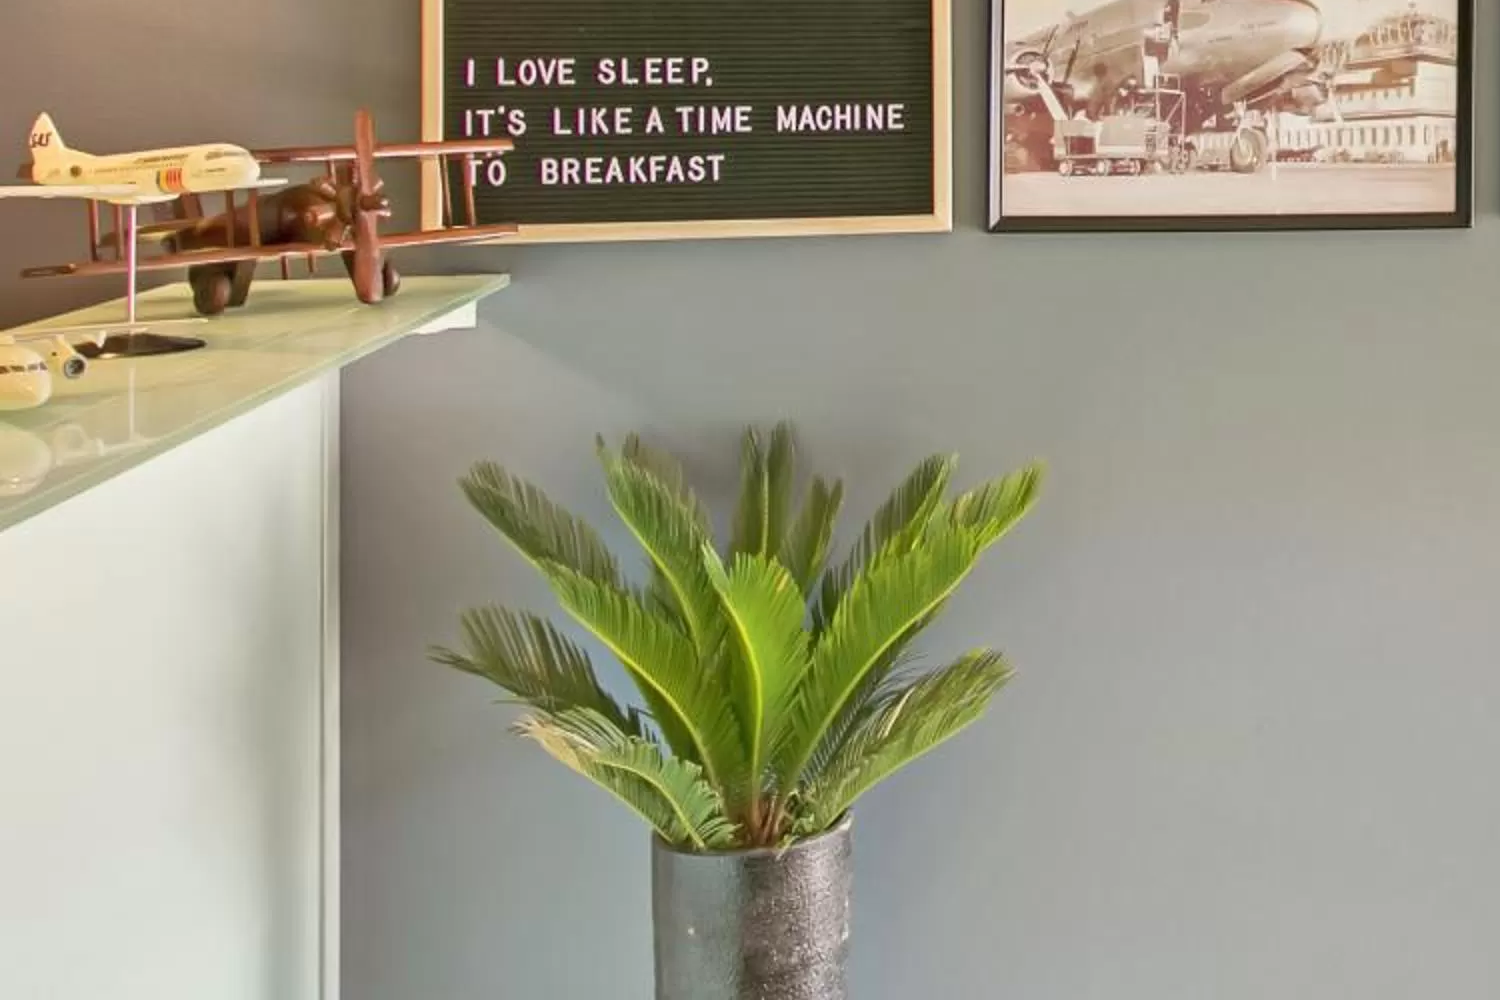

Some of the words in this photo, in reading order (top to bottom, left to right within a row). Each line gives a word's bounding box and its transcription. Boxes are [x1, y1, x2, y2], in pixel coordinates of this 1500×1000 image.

[467, 59, 475, 86] I
[498, 57, 576, 86] LOVE
[597, 57, 713, 87] SLEEP,
[465, 105, 527, 137] IT'S
[554, 107, 633, 135] LIKE
[645, 106, 665, 134] A
[675, 105, 753, 135] TIME
[777, 103, 905, 133] MACHINE
[541, 154, 725, 185] BREAKFAST
